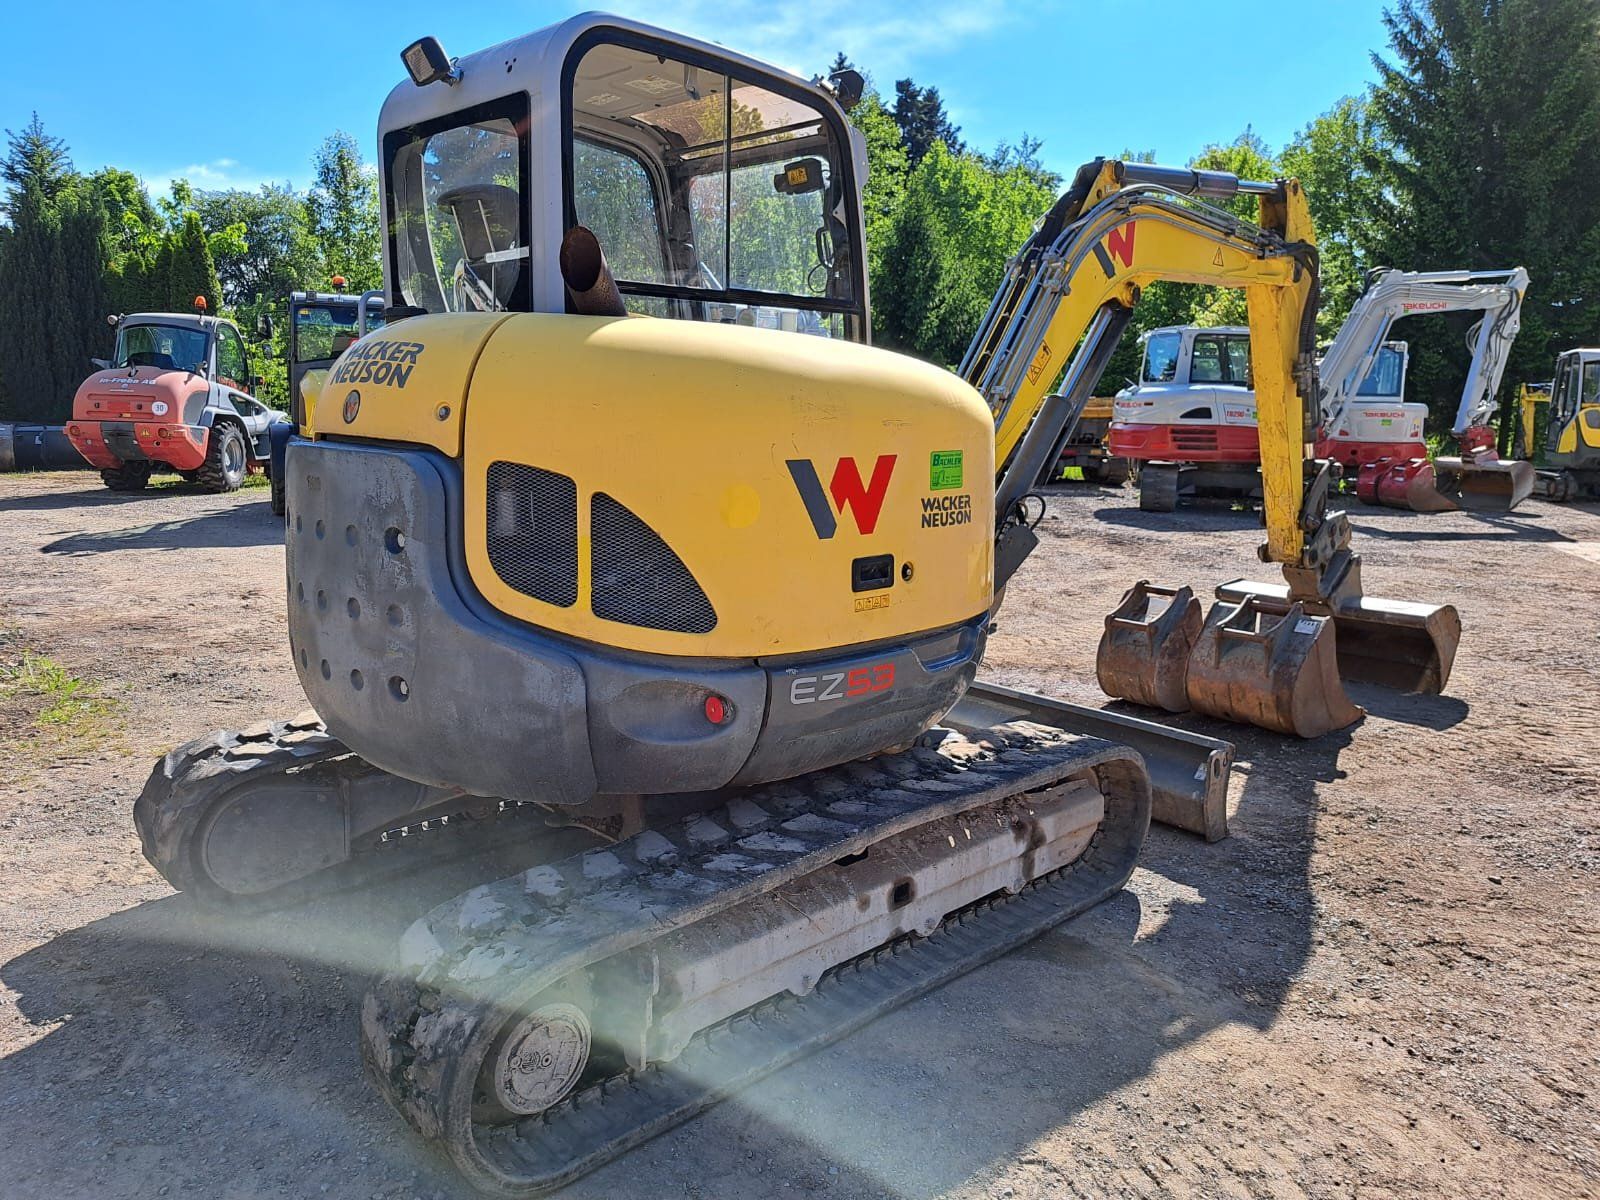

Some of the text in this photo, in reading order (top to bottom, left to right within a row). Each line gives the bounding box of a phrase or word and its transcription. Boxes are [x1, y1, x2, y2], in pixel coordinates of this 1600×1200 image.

[1400, 302, 1447, 310] TAKEUCHI
[330, 361, 414, 389] NEUSON
[155, 404, 164, 412] 30
[785, 454, 898, 540] W
[920, 494, 971, 513] WACKER
[921, 510, 972, 529] NEUSON
[790, 662, 896, 706] EZ53
